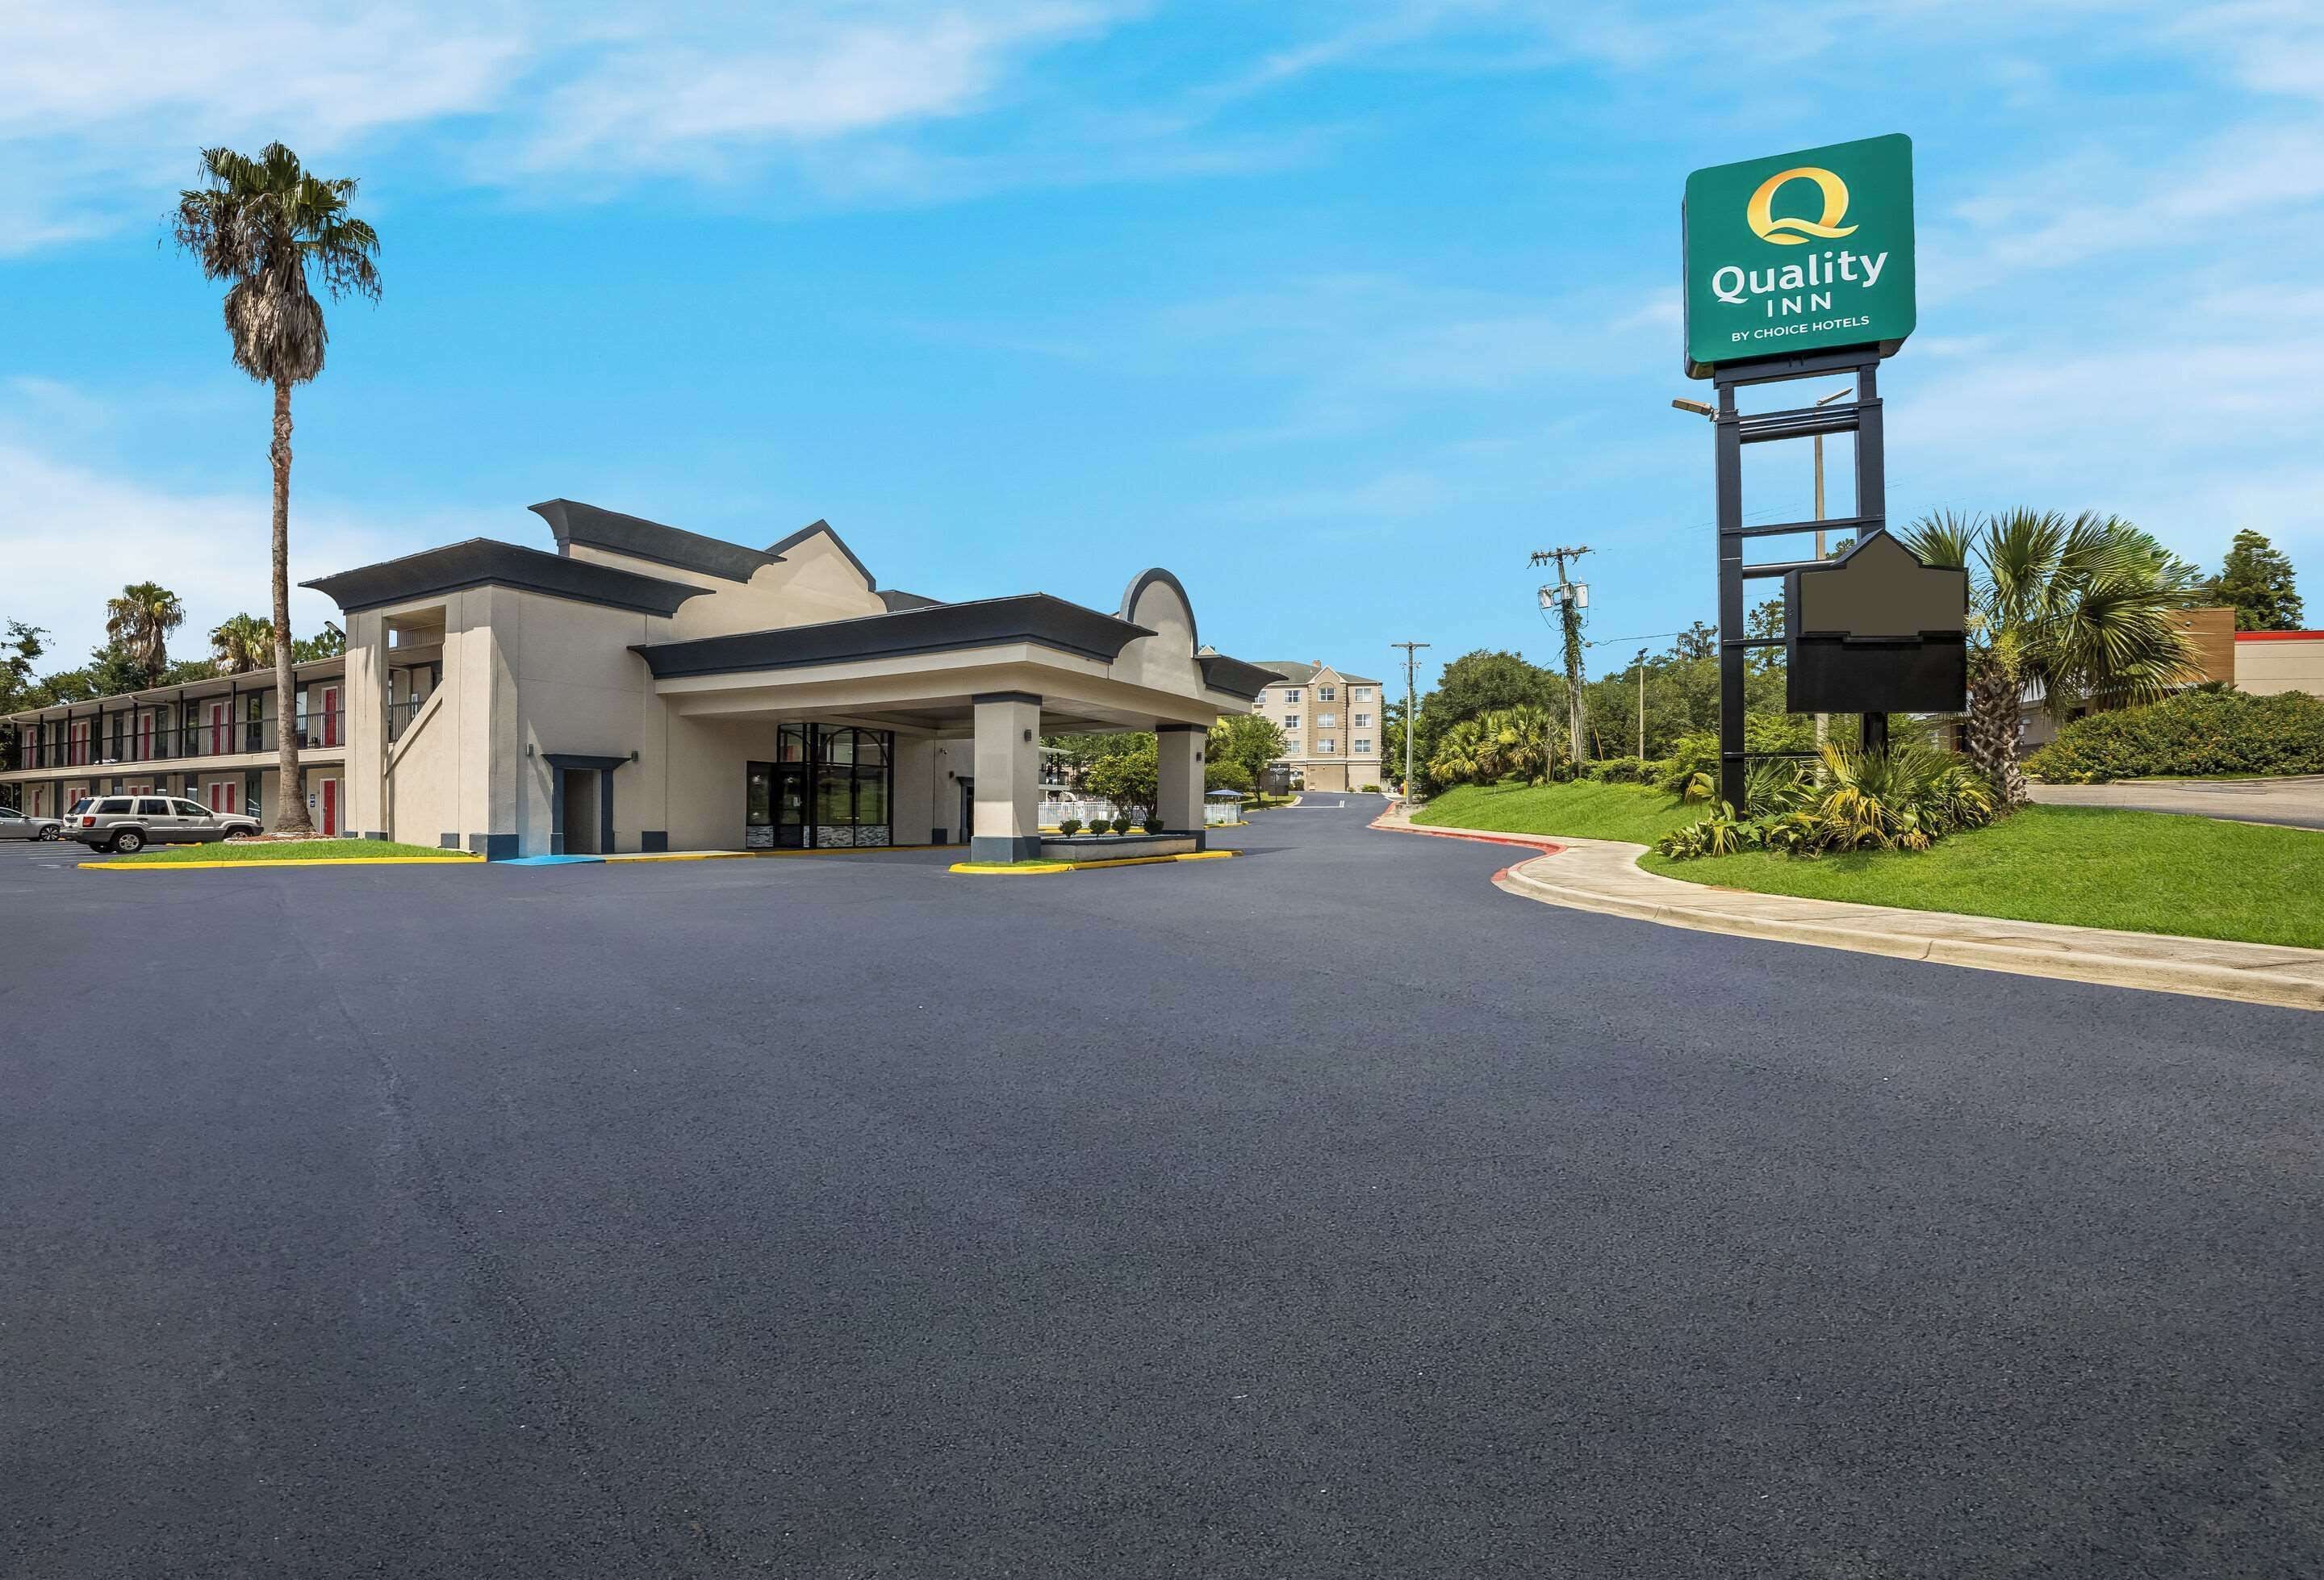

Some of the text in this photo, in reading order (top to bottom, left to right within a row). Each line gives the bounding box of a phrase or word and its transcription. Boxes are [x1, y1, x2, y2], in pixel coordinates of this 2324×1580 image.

[1747, 167, 1859, 245] Q
[1712, 250, 1888, 304] Quality
[1767, 291, 1831, 317] INN
[1732, 316, 1870, 342] BY CHOICE HOTELS
